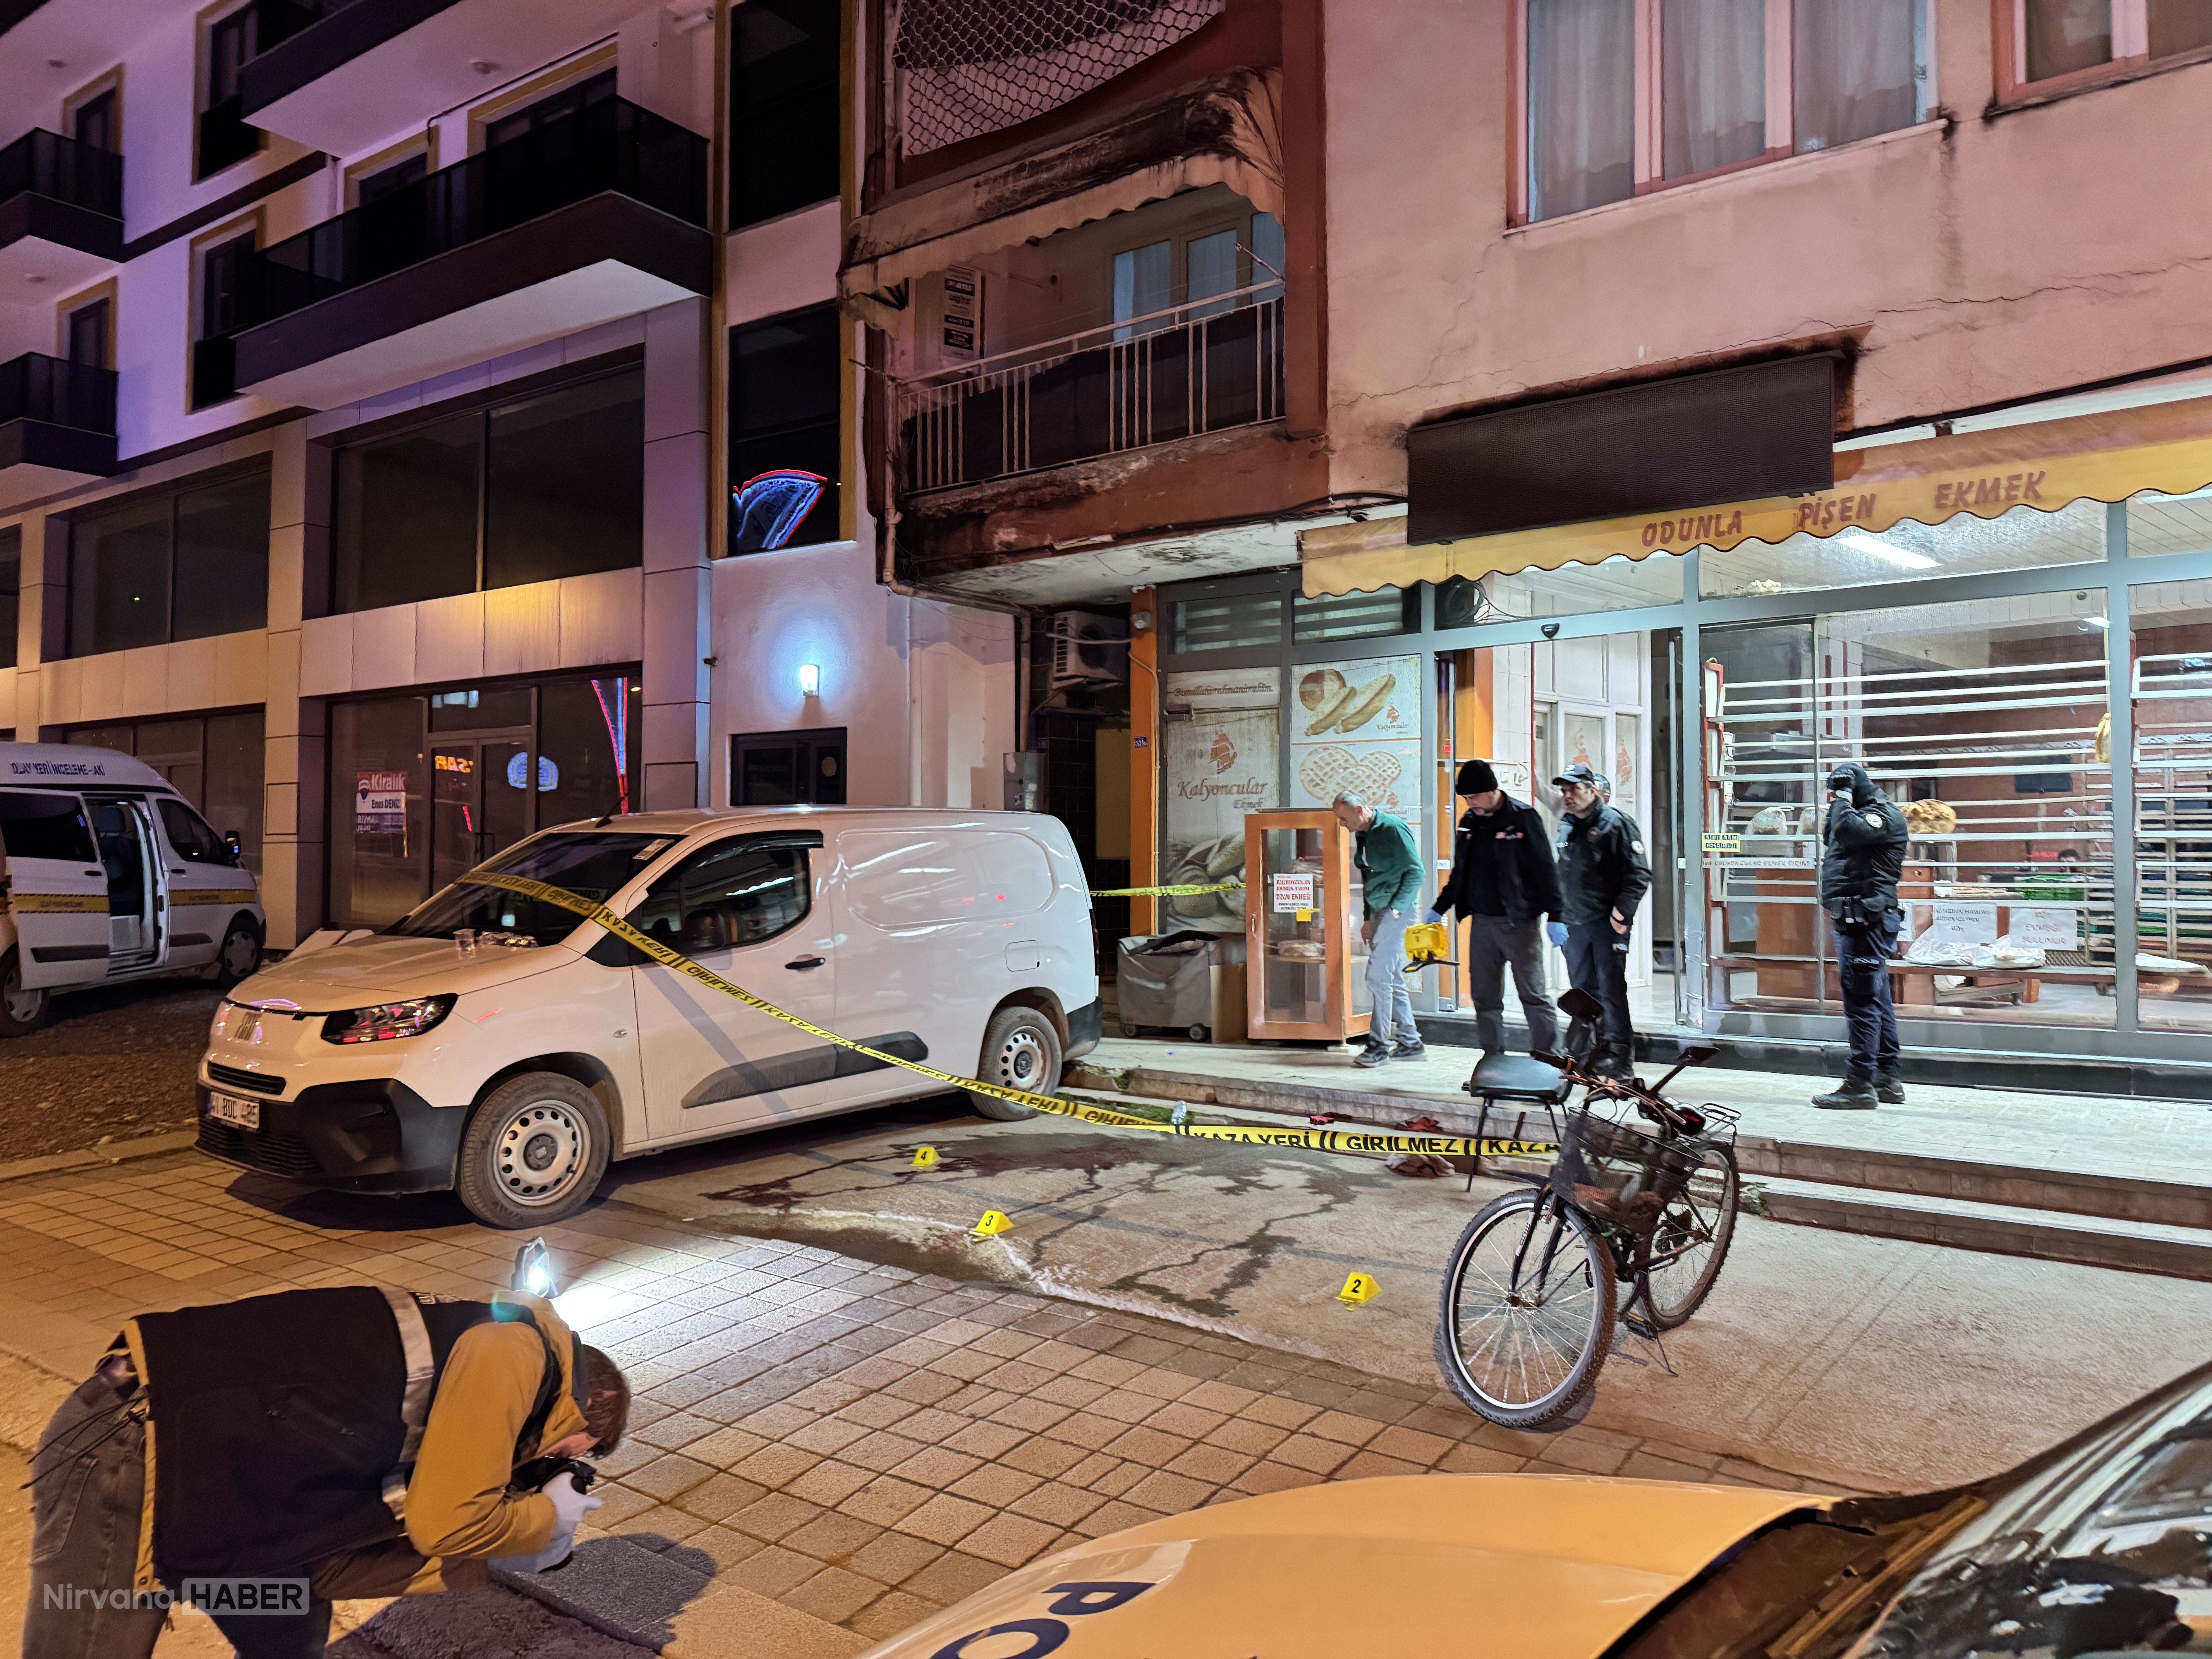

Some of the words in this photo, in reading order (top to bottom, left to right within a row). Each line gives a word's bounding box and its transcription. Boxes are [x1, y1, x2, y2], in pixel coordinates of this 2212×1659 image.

[1642, 510, 1742, 547] ODUNLA
[1798, 494, 1877, 530] PİŞEN
[1934, 471, 2046, 509] EKMEK
[1178, 777, 1268, 801] Kalyoncular
[1346, 1134, 1459, 1153] GİRİLMEZ
[921, 1151, 927, 1160] 4
[985, 1215, 994, 1226] 3
[1351, 1279, 1362, 1294] 2
